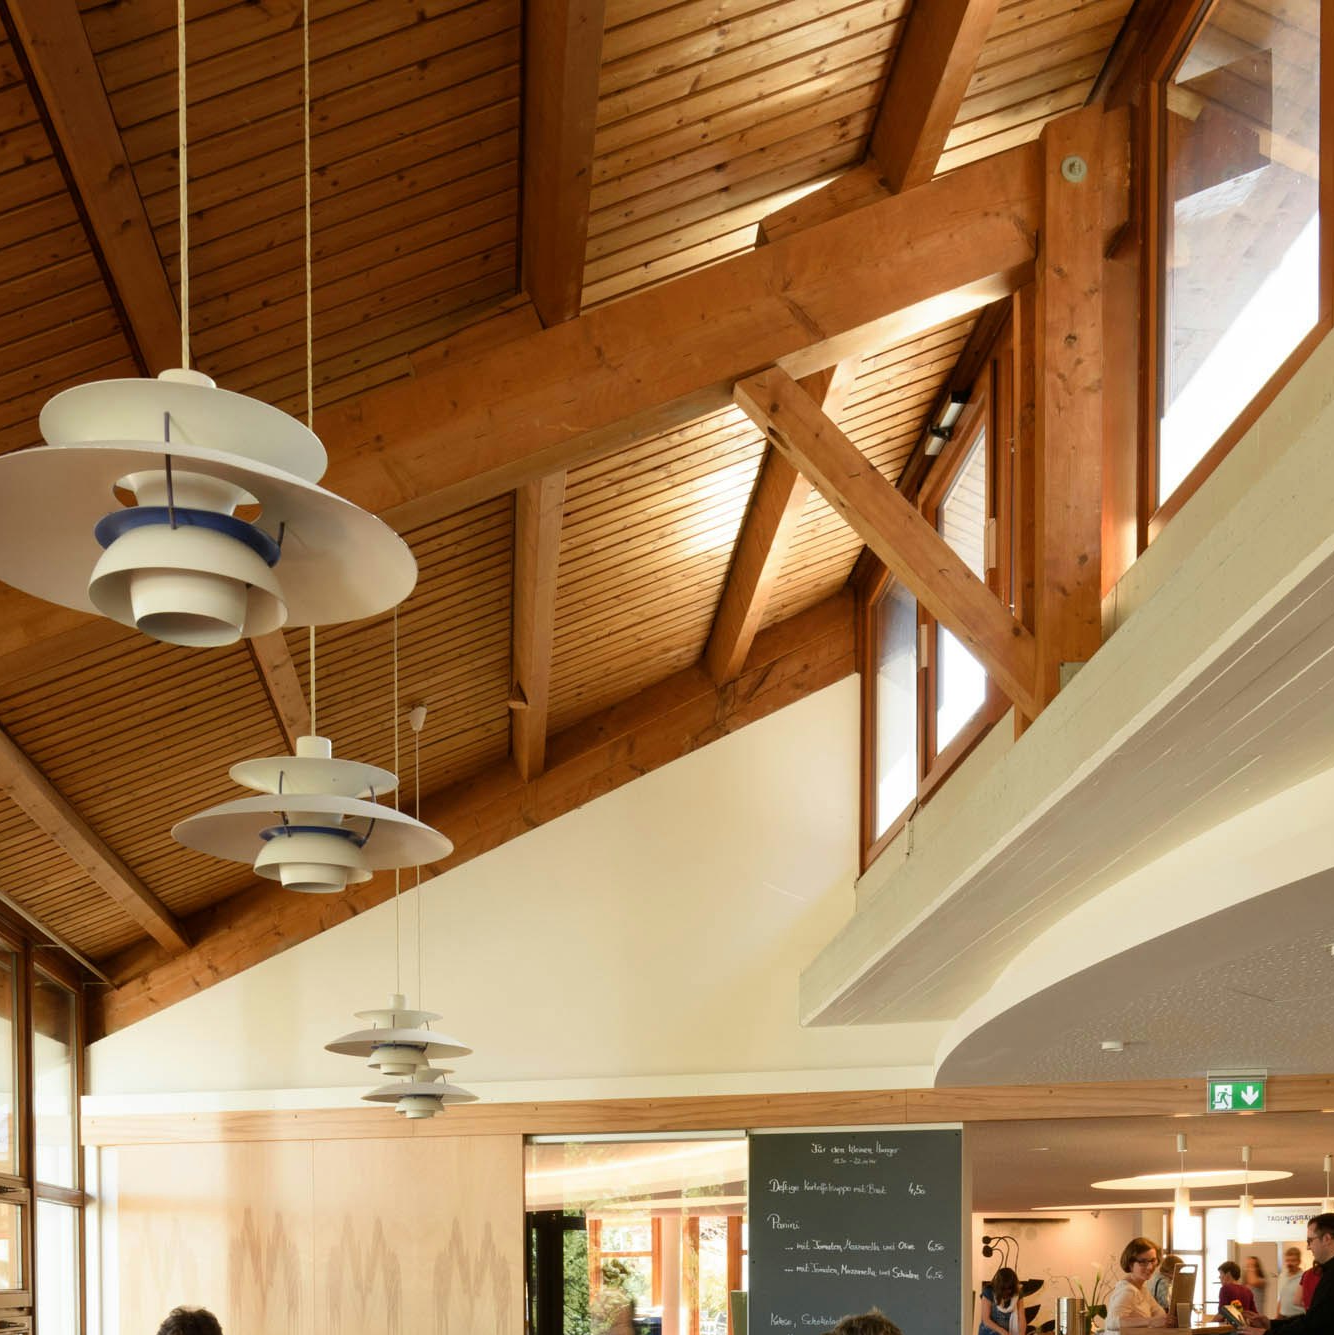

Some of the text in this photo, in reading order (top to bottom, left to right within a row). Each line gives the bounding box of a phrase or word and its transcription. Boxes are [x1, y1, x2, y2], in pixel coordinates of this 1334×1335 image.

[811, 1143, 826, 1153] Für
[769, 1178, 800, 1194] Deftige
[853, 1184, 866, 1193] mit
[867, 1183, 887, 1194] Brot
[767, 1213, 800, 1230] Panini
[796, 1240, 811, 1250] mit
[882, 1241, 895, 1250] und
[796, 1263, 811, 1272] mit
[801, 1312, 843, 1326] Schokolad
